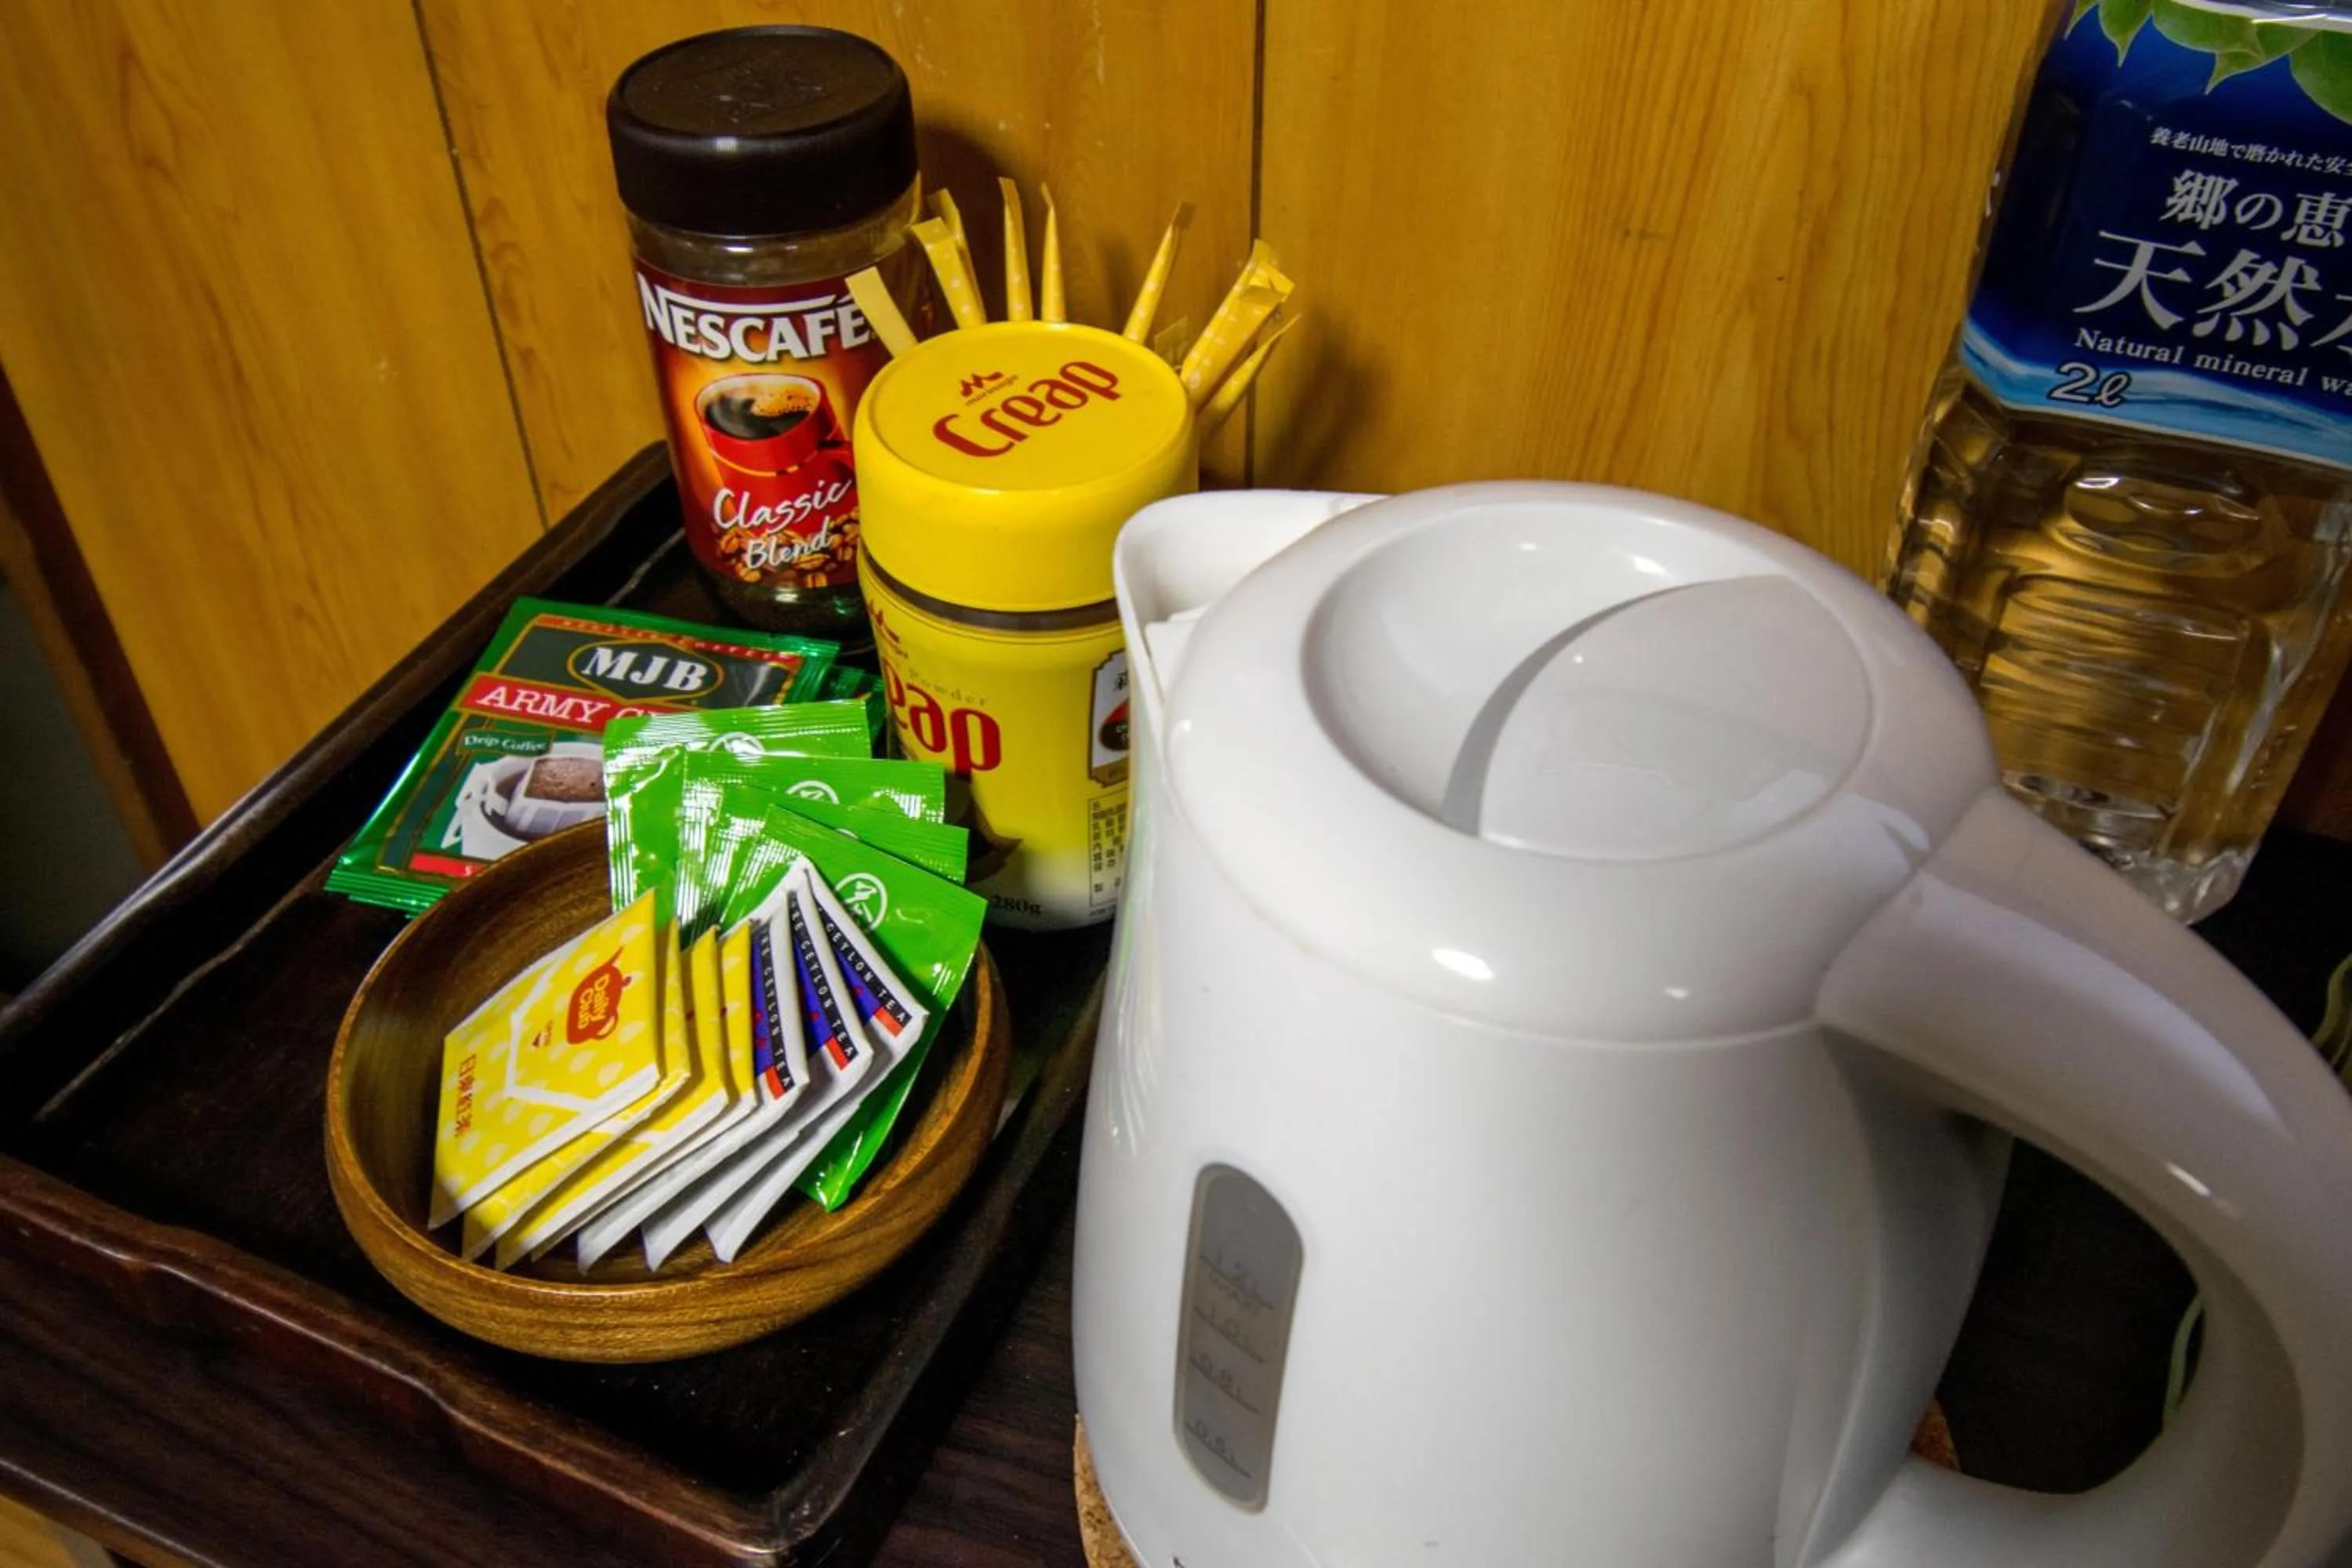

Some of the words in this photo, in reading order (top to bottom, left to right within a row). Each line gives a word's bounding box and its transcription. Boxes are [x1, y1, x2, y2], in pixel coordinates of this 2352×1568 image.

[2074, 327, 2184, 365] Natural
[2194, 352, 2309, 387] mineral
[931, 361, 1122, 458] Creap
[713, 478, 852, 535] Classic
[745, 516, 833, 570] Blend
[580, 646, 709, 691] MJB
[476, 685, 612, 724] ARMY
[463, 735, 499, 749] Drip
[501, 738, 547, 753] Coffee
[590, 972, 611, 1022] Daily
[800, 939, 833, 1008] CEYLON
[832, 1018, 854, 1057] TEA
[826, 921, 874, 982] CEYLON
[877, 989, 905, 1023] TEA
[577, 987, 593, 1030] Club
